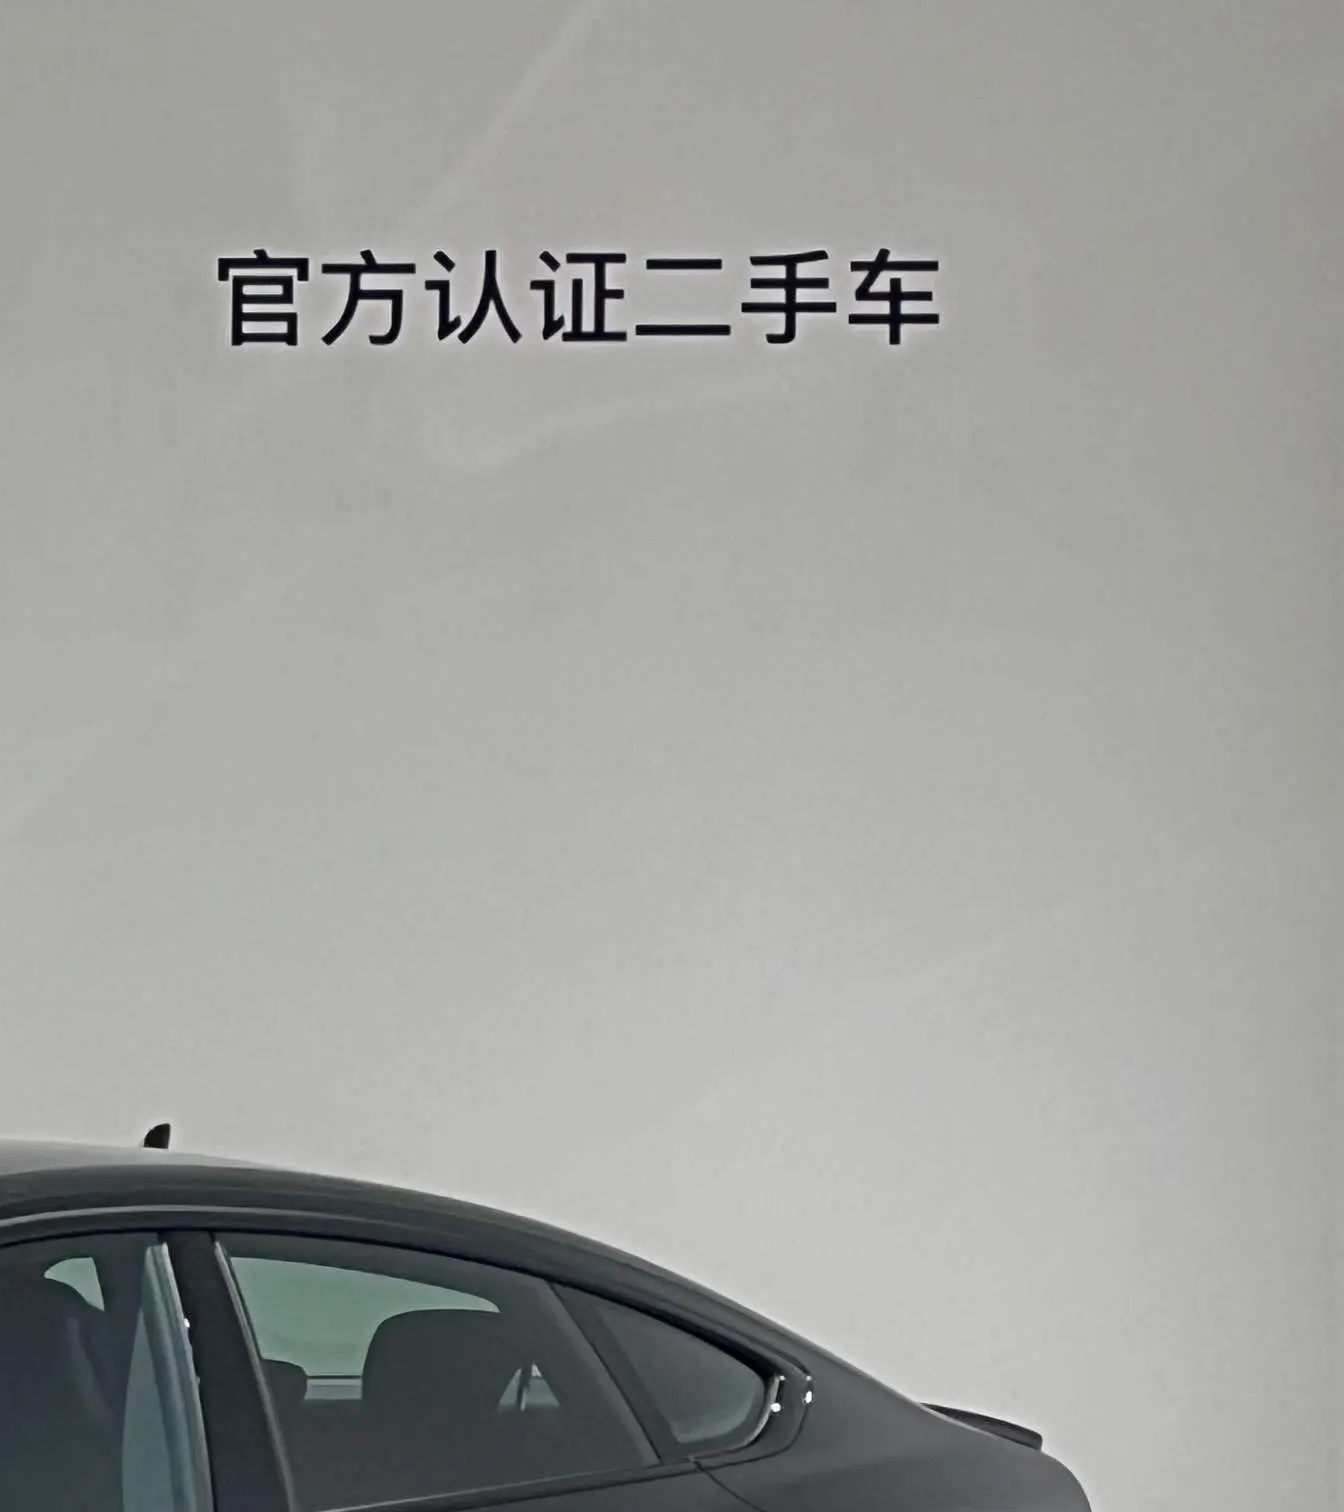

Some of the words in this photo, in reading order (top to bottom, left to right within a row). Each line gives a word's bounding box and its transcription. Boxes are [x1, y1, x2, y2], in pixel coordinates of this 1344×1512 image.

[218, 248, 939, 346] 官方认证二手车
